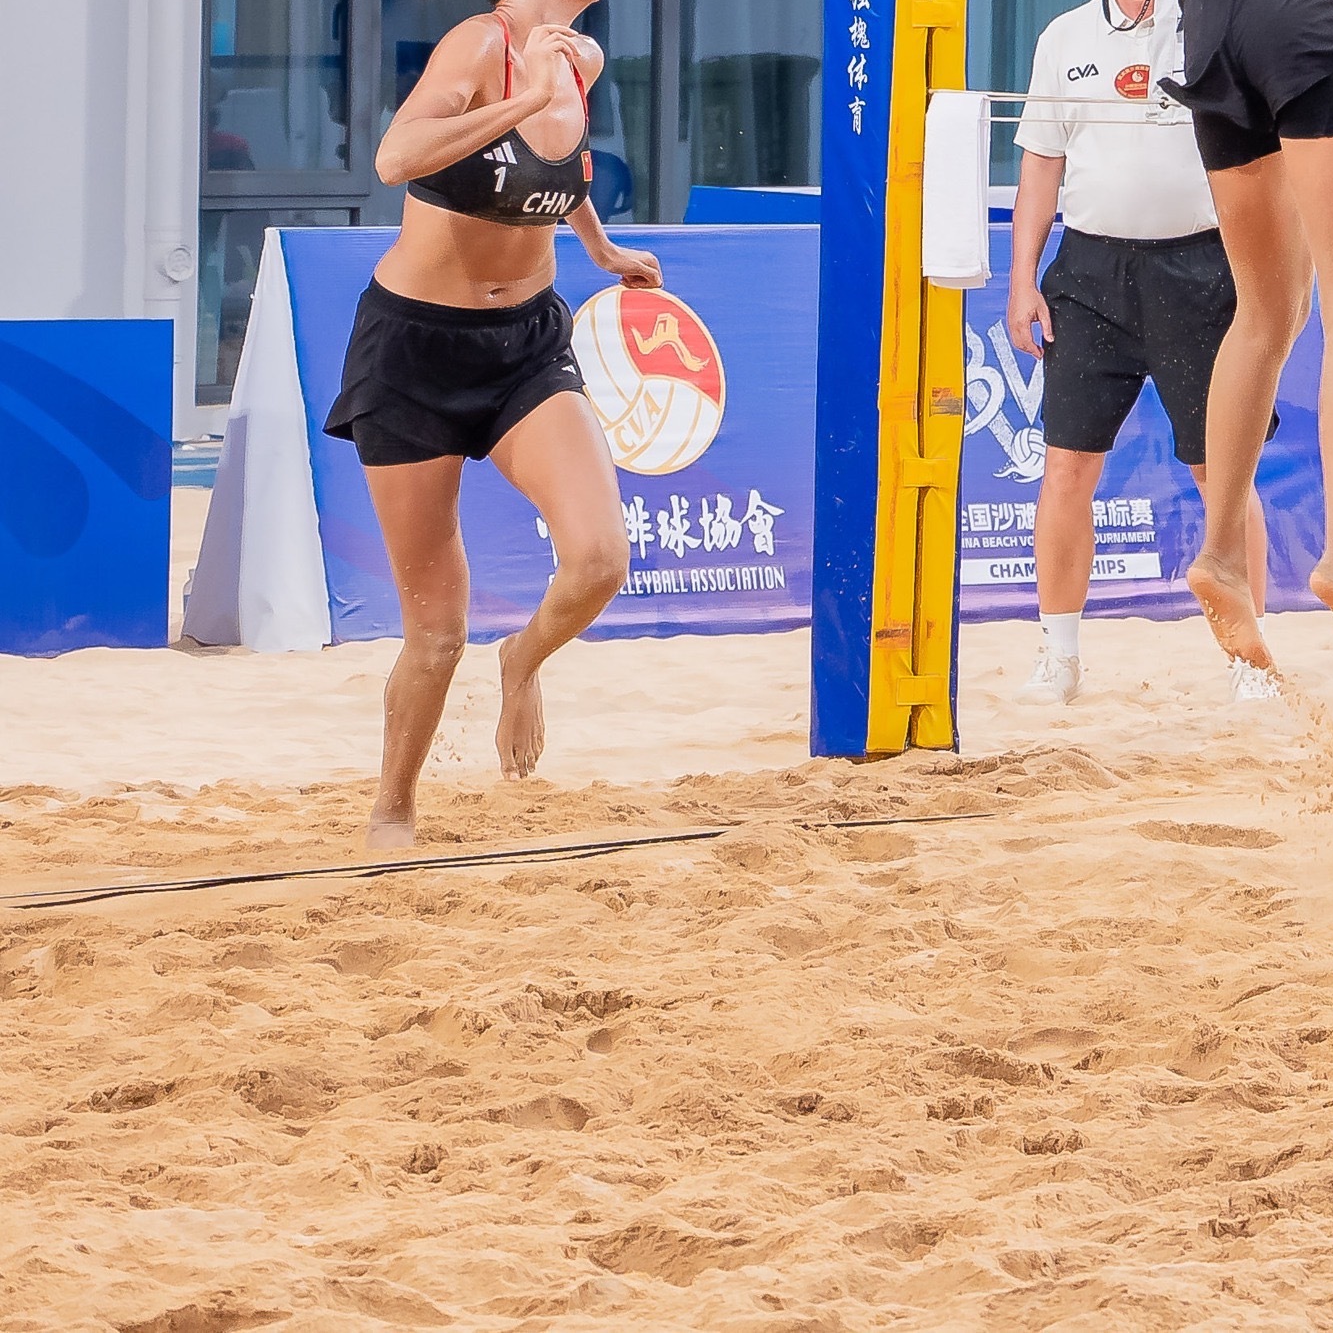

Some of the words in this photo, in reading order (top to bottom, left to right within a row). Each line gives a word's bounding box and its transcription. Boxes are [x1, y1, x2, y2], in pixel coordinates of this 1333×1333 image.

[1067, 63, 1099, 82] CVA
[494, 166, 507, 193] 1
[522, 192, 574, 215] CHN
[613, 389, 662, 454] CVA
[982, 536, 1018, 548] BEACH
[690, 566, 786, 591] ASSOCIATION
